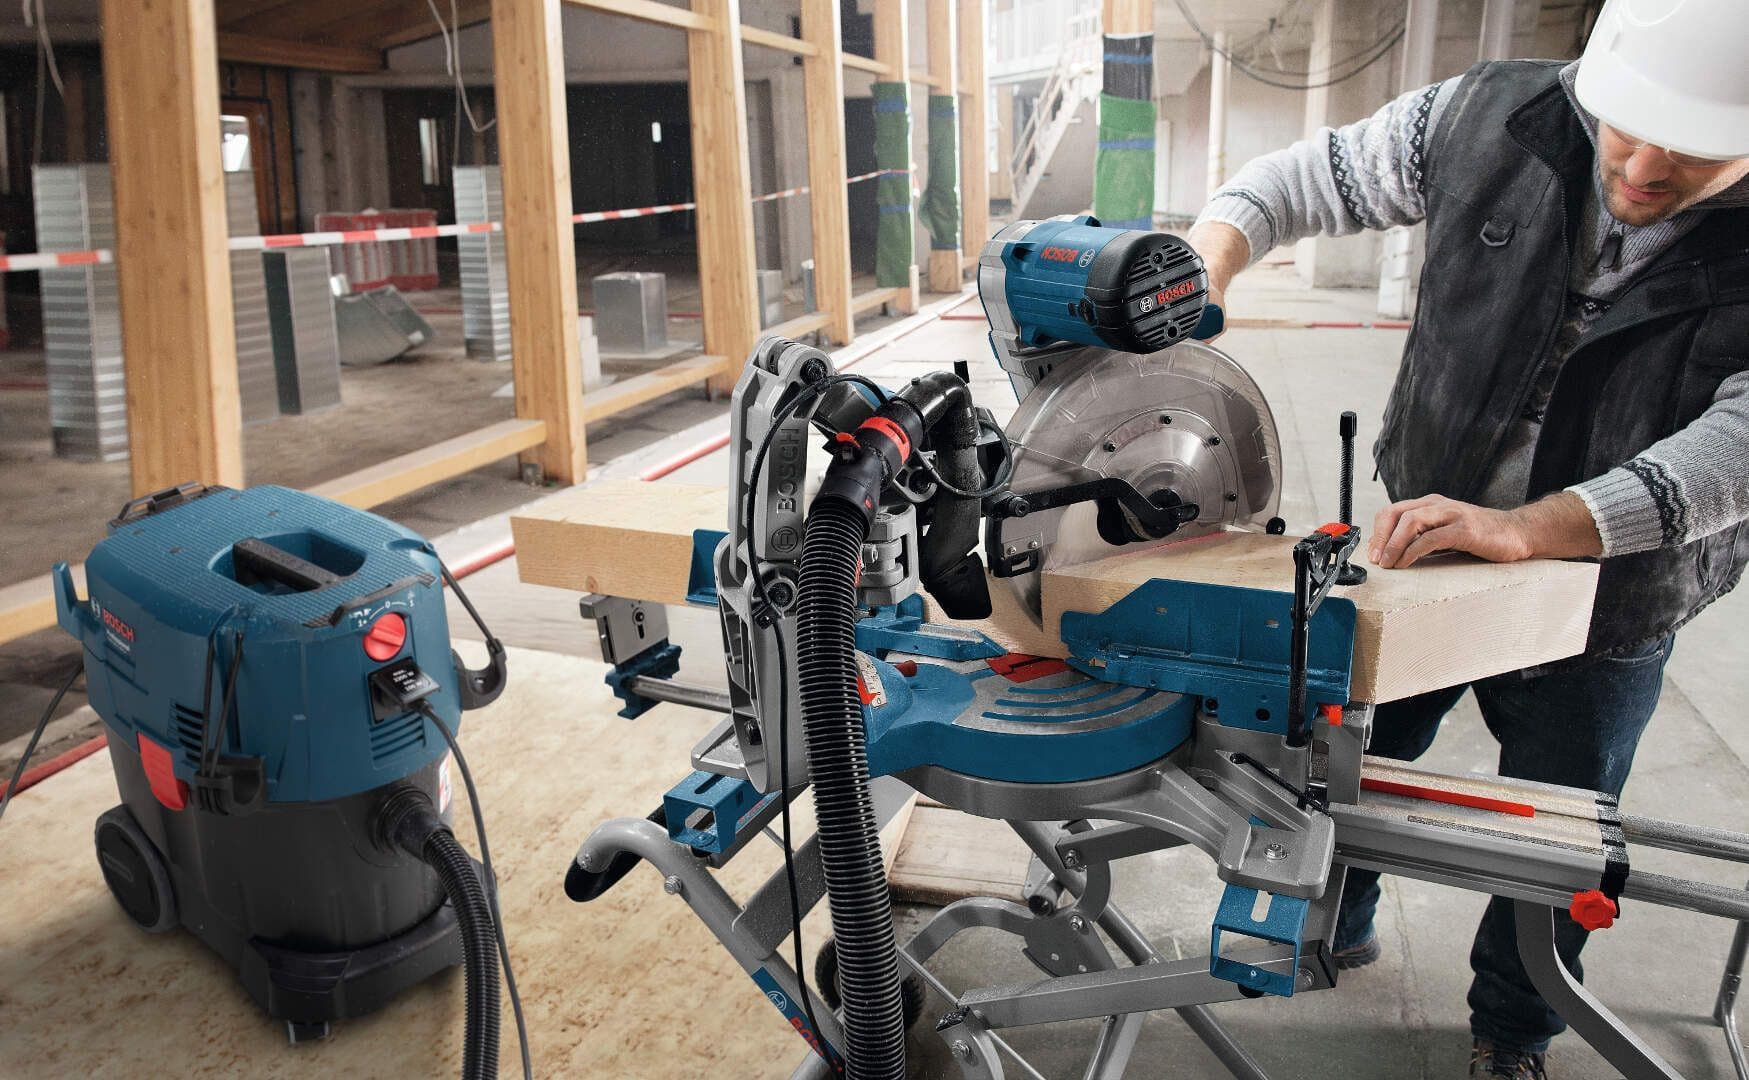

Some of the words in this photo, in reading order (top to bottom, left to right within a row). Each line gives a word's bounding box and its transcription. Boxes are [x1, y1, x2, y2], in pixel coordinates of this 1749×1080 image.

[1041, 246, 1079, 262] BOSCH
[1156, 279, 1195, 305] BOSCH
[776, 427, 800, 514] BOSCH
[102, 607, 134, 642] BOSCH
